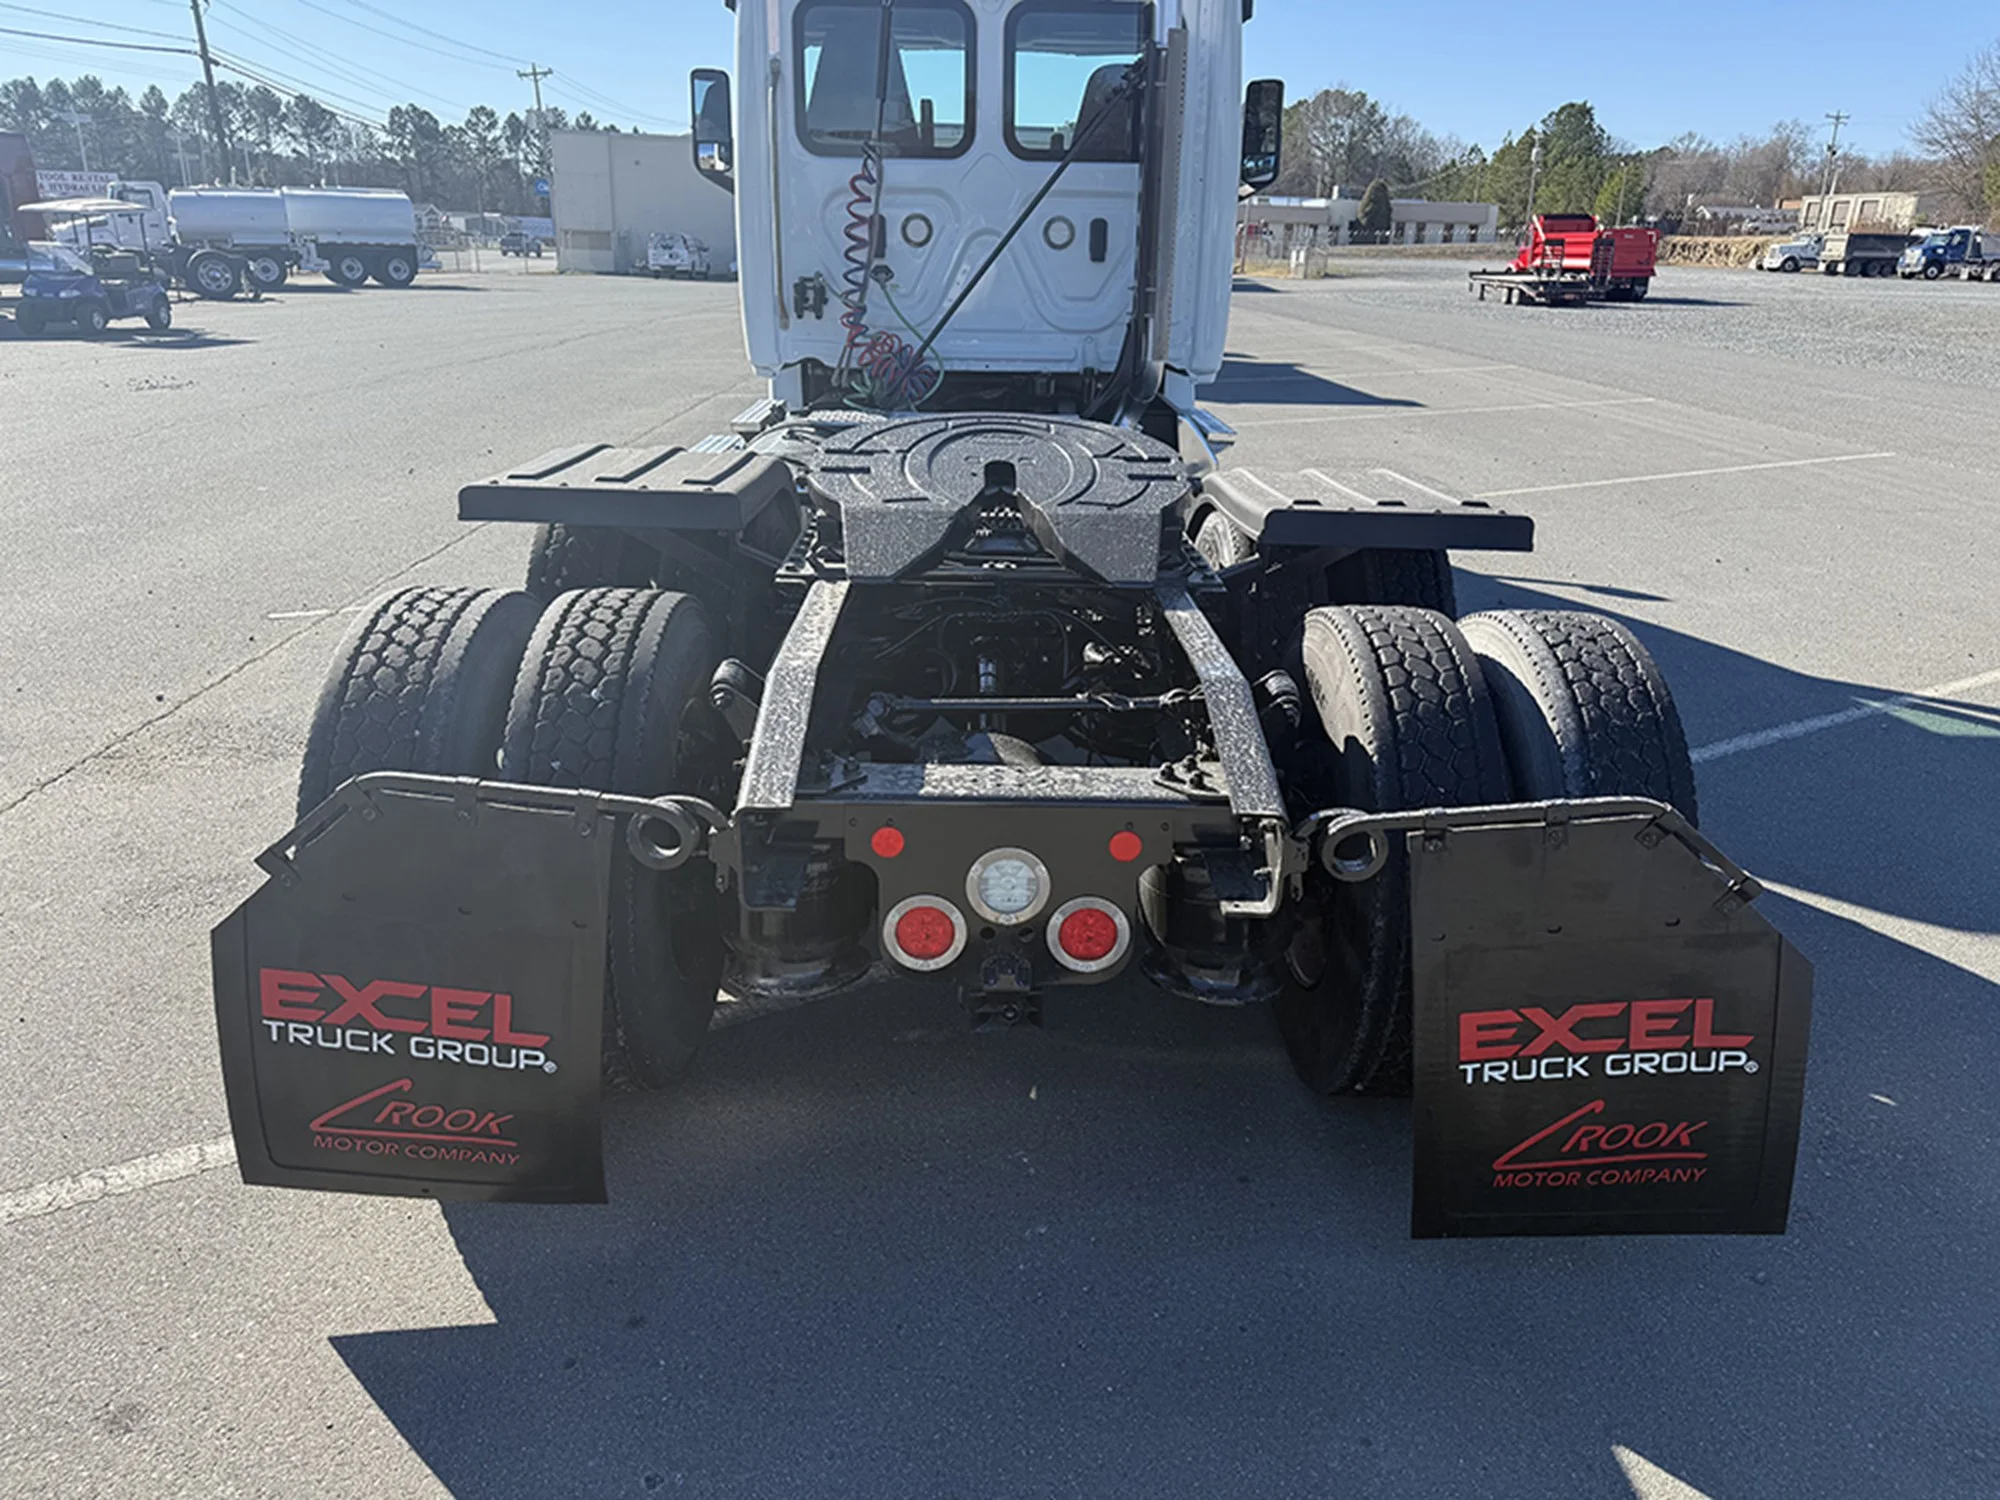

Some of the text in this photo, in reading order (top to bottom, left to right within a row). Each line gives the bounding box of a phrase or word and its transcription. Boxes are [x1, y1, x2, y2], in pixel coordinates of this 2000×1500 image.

[259, 967, 551, 1048] EXCEL
[262, 1019, 396, 1055] TRUCK
[1459, 998, 1755, 1061] EXCEL
[1459, 1055, 1590, 1084] TRUCK
[313, 1134, 521, 1166] MOTOR COMPANY
[1493, 1167, 1708, 1188] MOTOR COMPANY
